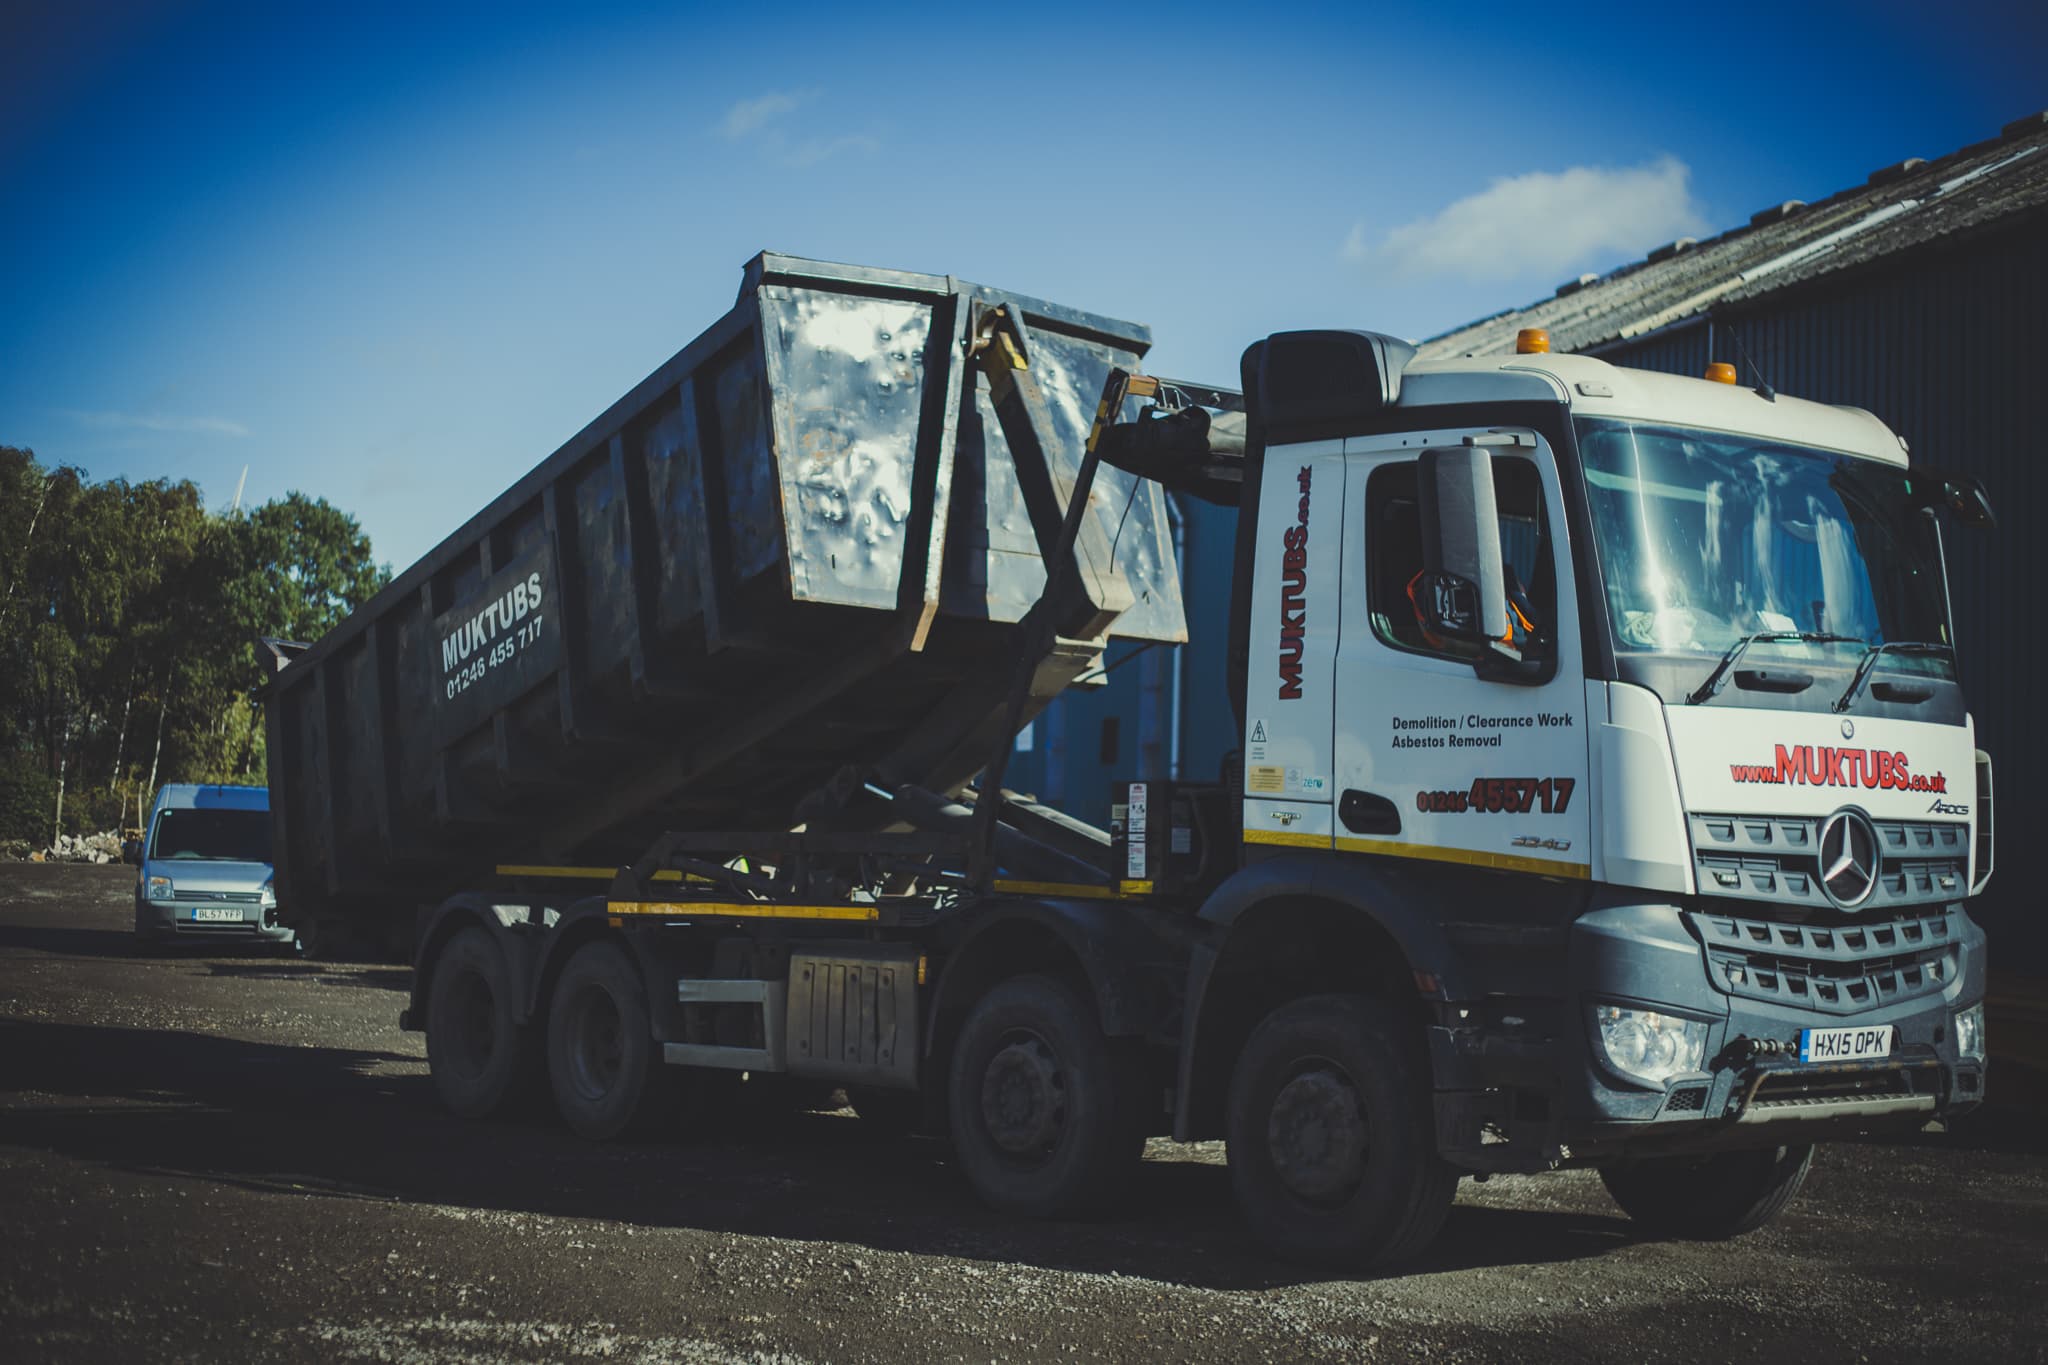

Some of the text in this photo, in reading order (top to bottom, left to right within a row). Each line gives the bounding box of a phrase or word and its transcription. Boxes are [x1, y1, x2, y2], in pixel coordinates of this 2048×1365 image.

[443, 572, 542, 673] MUKTUBS
[447, 615, 543, 700] 01246 455 717
[1392, 716, 1456, 730] Demolition
[1467, 714, 1533, 729] Clearance
[1537, 712, 1573, 727] Work
[1391, 734, 1502, 749] Asbestos Removal
[1730, 744, 1948, 794] www.MUKTUBS.co.uk
[1815, 1030, 1886, 1057] HX15 OPK
